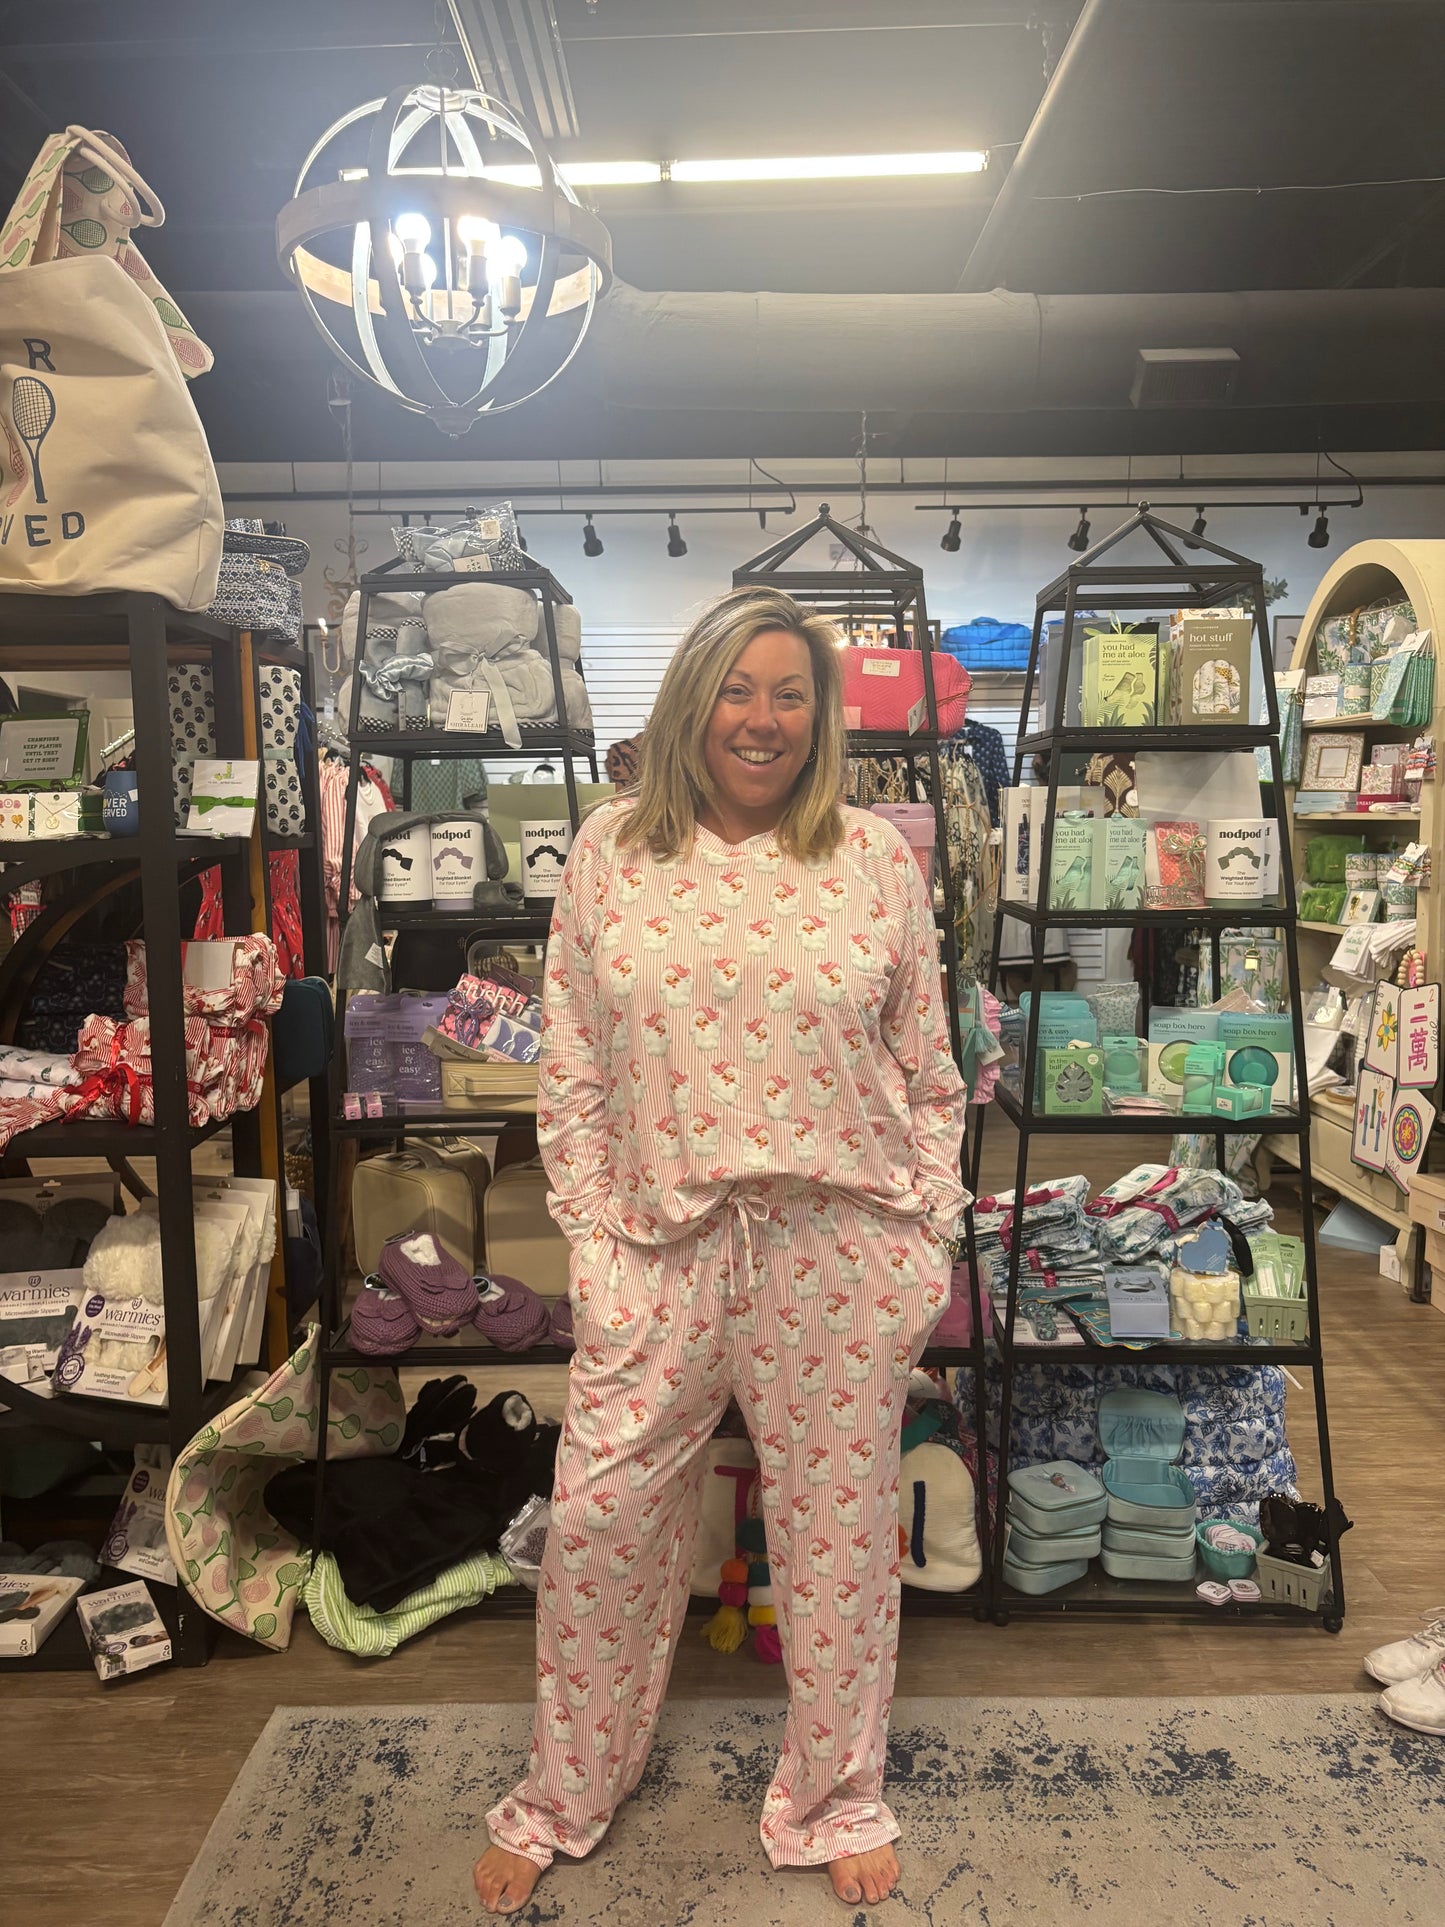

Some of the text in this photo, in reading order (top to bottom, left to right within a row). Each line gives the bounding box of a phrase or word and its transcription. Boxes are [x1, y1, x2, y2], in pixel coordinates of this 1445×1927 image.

[23, 338, 56, 371] R
[1189, 632, 1233, 642] hot stuff
[1102, 643, 1135, 652] you had
[385, 830, 411, 842] pod
[432, 829, 471, 841] nodpod
[525, 827, 565, 839] nodpod
[1055, 830, 1069, 838] you
[1109, 829, 1120, 837] you
[1219, 829, 1262, 840] nodpod
[1187, 1022, 1206, 1030] hero
[1258, 1028, 1277, 1036] hero
[405, 1056, 413, 1064] &
[399, 1065, 421, 1075] easy
[0, 1284, 71, 1302] warmies
[105, 1308, 160, 1326] warmies
